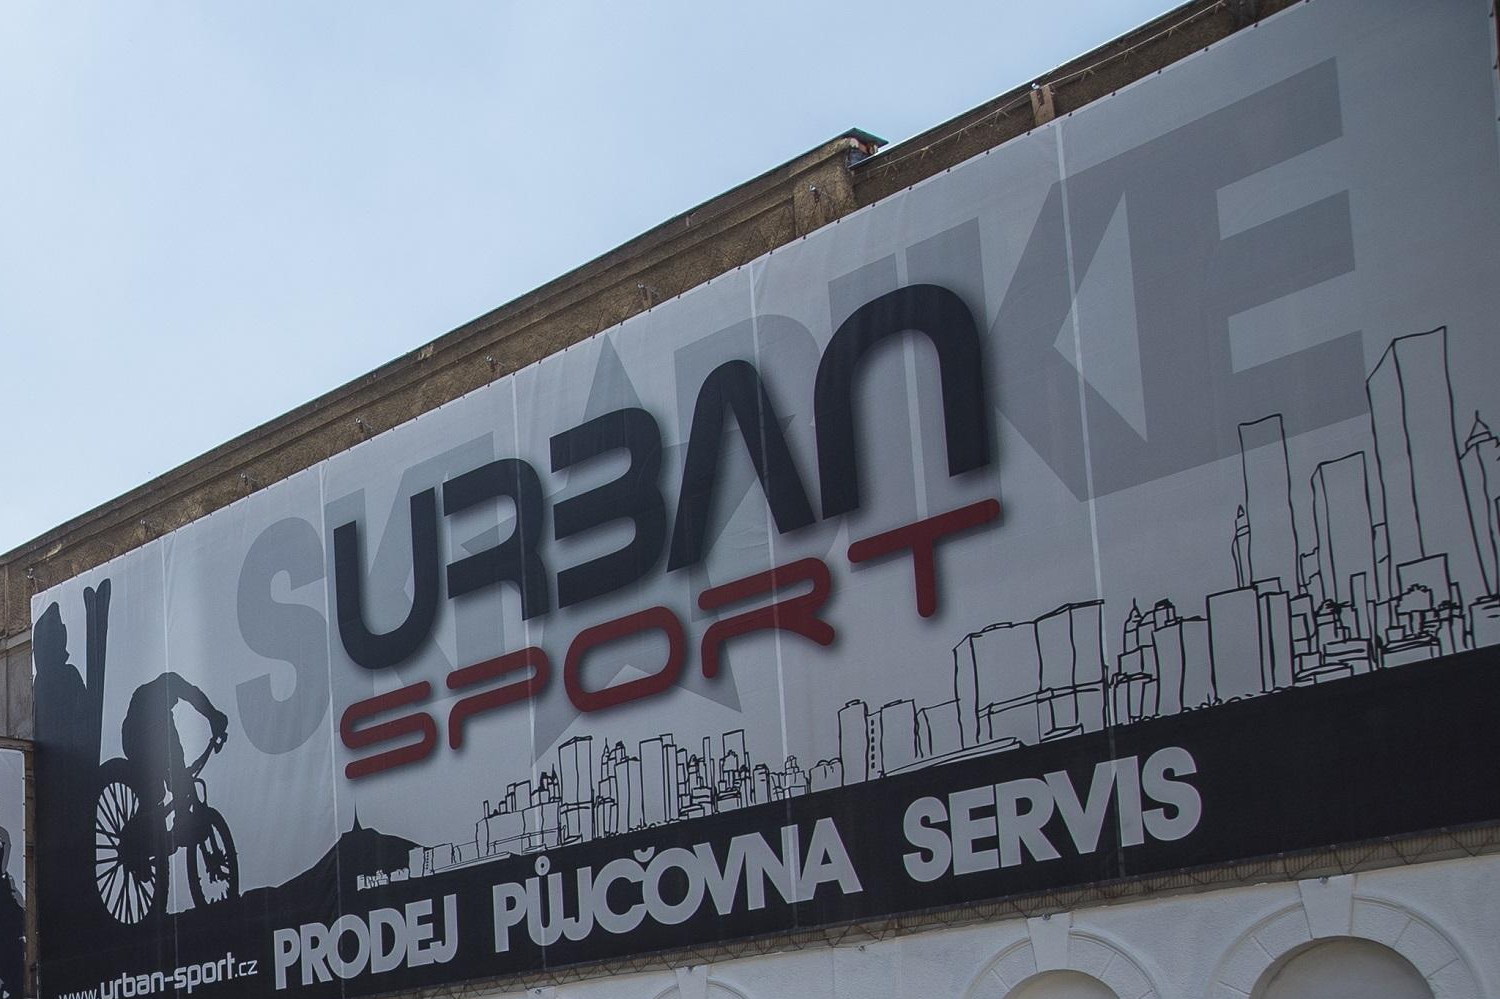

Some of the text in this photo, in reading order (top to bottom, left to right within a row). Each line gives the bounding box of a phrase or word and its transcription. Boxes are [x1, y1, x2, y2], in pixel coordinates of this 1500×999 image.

[334, 283, 990, 669] URBAN
[339, 498, 1001, 781] SPORT
[273, 746, 1203, 991] PRODEJ PŮJČOVNA SERVIS
